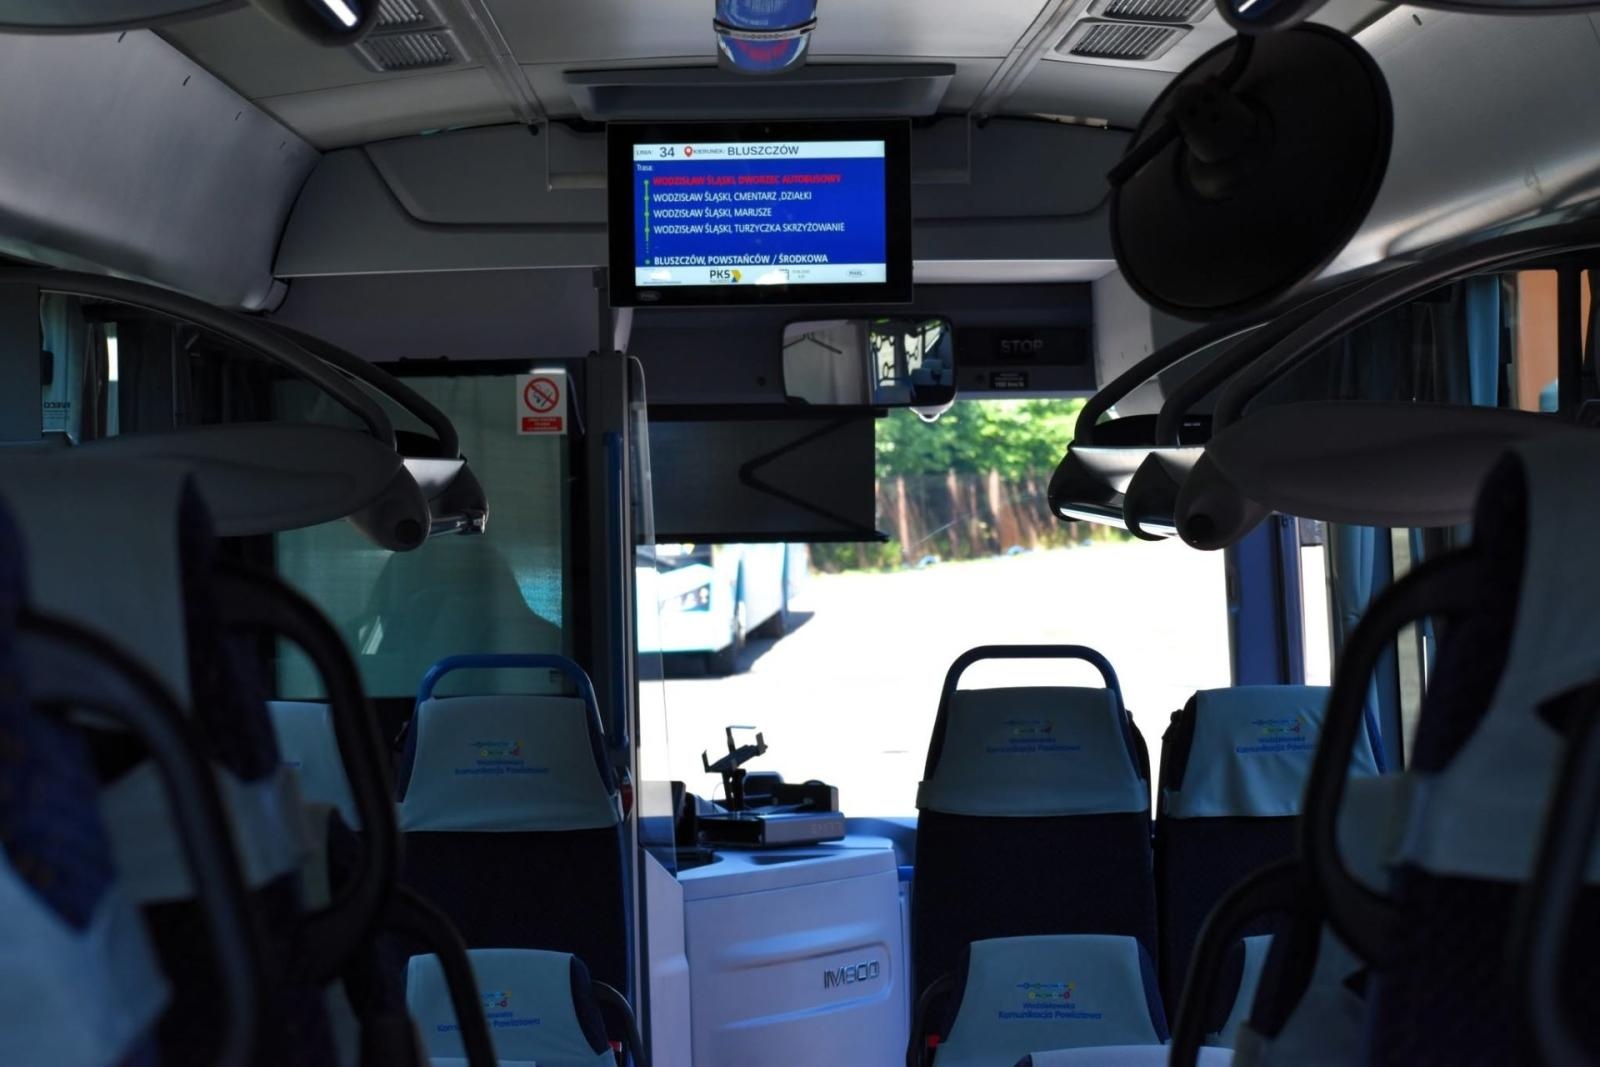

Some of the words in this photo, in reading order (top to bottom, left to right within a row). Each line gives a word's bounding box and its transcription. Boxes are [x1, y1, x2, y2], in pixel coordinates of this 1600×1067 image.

[660, 146, 675, 158] 34
[727, 144, 800, 156] BLUSZCZÓW
[653, 192, 703, 202] WODZISŁAW
[704, 190, 732, 203] ŚLĄSKI,
[734, 191, 777, 201] CMENTARZ
[653, 208, 703, 218] WODZISŁAW
[704, 207, 733, 219] ŚLĄSKI,
[734, 207, 772, 217] MARUSZE
[653, 225, 703, 234] WODZISŁAW
[704, 222, 733, 235] ŚLĄSKI,
[735, 223, 781, 233] TURZYCZKA
[782, 222, 845, 232] SKRZYŻOWANIE
[654, 254, 707, 266] BLUSZCZÓW,
[708, 254, 771, 265] POWSTAŃCÓW
[778, 253, 829, 264] ŚRODKOWA
[709, 269, 731, 279] PKS
[1001, 339, 1044, 353] STOP
